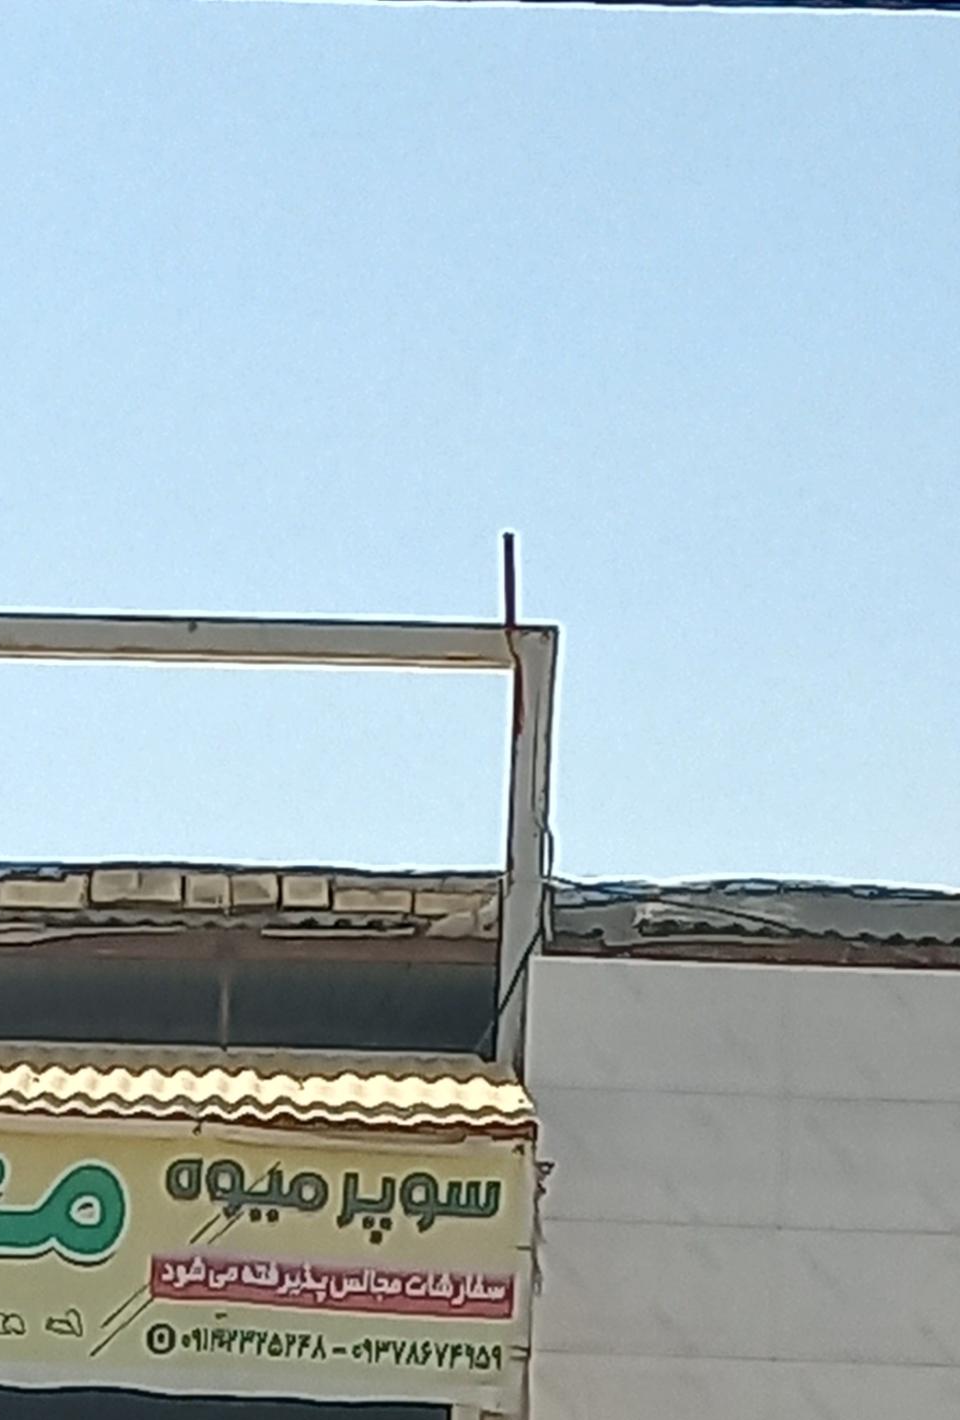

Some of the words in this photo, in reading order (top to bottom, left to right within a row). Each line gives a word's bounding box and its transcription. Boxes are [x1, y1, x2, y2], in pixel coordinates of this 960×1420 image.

[165, 1158, 329, 1220] میوه
[336, 1171, 502, 1245] سوپر
[241, 1261, 329, 1303] پذیرفته
[329, 1268, 403, 1302] مجالس
[405, 1270, 506, 1305] سفارشات
